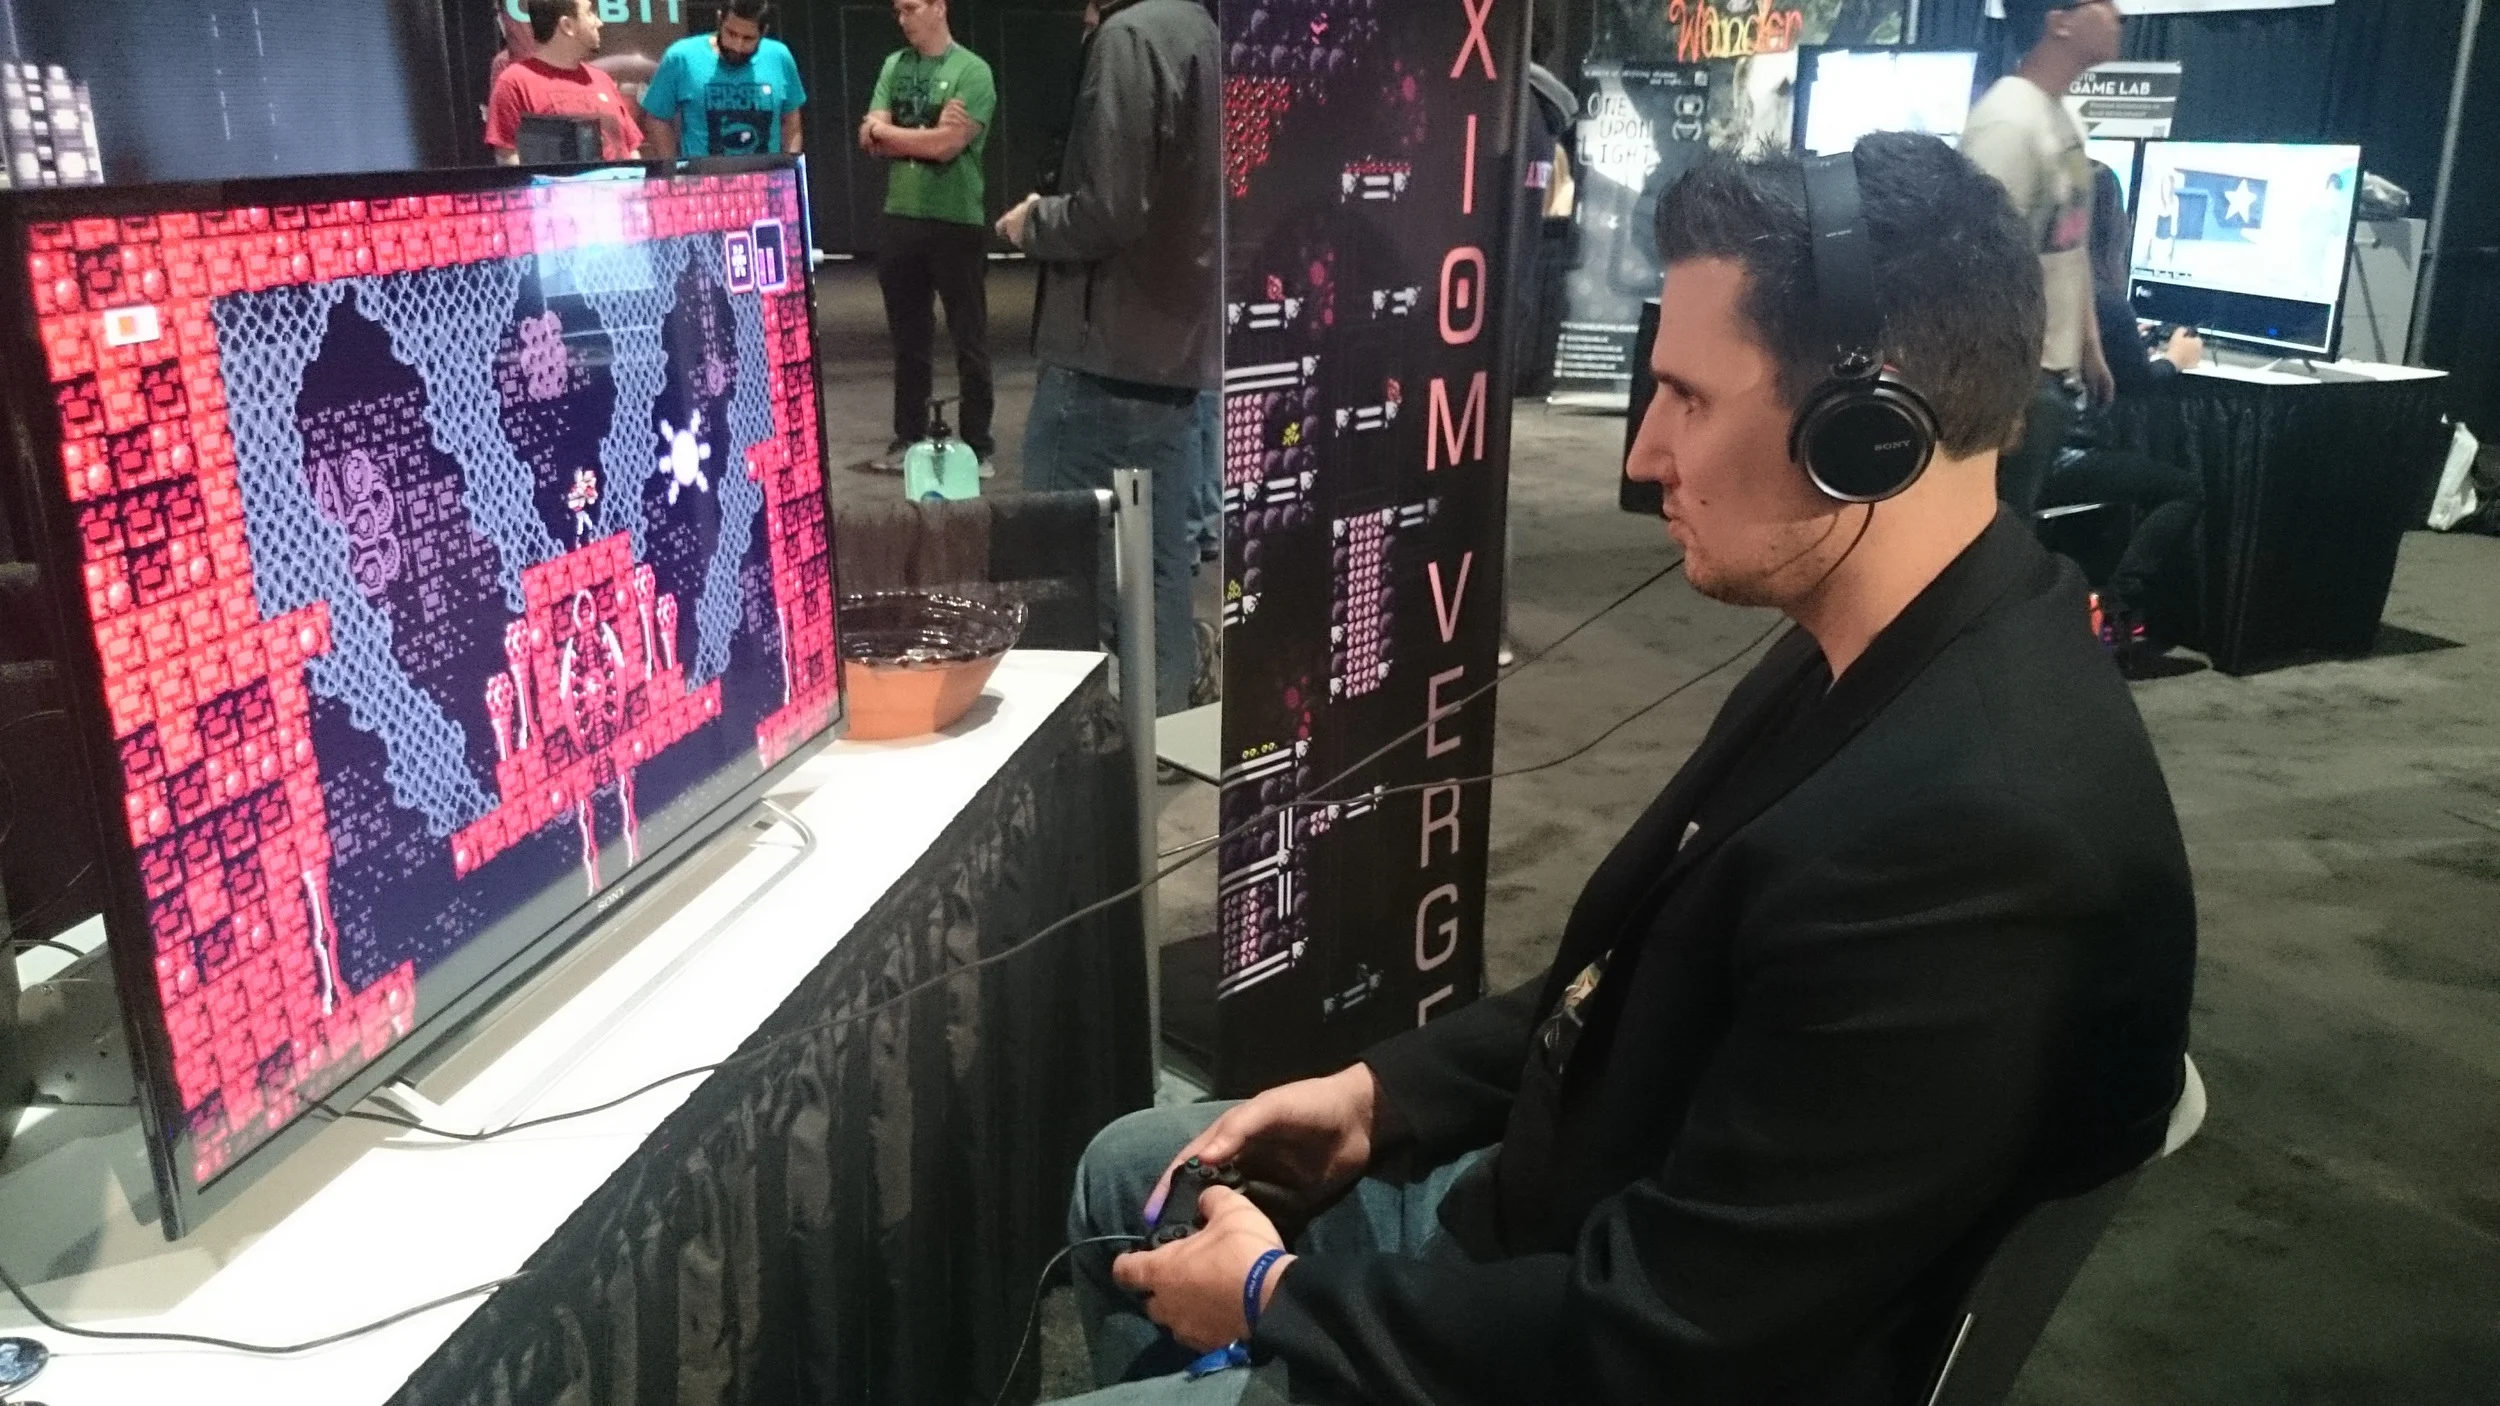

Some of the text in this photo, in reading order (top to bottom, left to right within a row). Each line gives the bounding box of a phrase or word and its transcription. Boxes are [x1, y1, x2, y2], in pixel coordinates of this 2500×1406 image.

[1669, 0, 1803, 63] Wander
[2069, 81, 2150, 95] GAME LAB
[1587, 92, 1627, 118] ONE
[1599, 118, 1655, 139] UPON
[1577, 136, 1652, 165] LIGHT
[1874, 440, 1910, 451] SONY
[598, 885, 625, 912] SONY
